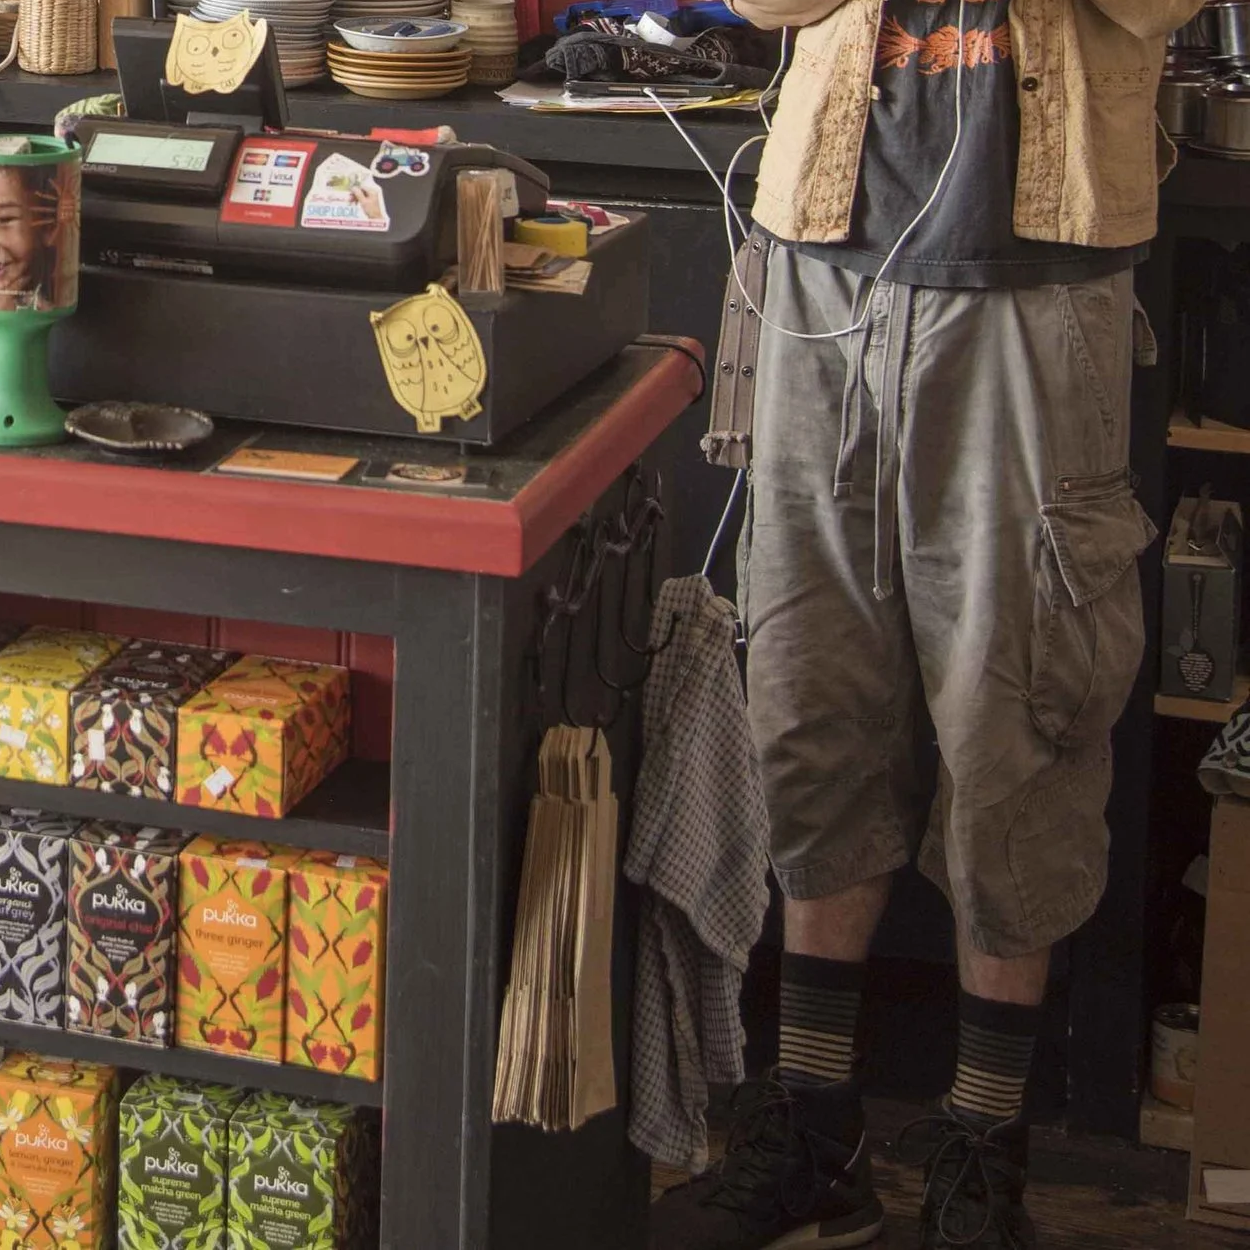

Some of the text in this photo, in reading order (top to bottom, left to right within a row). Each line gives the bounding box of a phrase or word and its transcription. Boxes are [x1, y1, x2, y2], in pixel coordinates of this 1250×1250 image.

[92, 889, 146, 914] pukka
[203, 904, 257, 929] pukka
[195, 928, 265, 949] three ginger
[15, 1129, 68, 1151] pukka
[145, 1152, 199, 1178] pukka
[141, 1184, 201, 1201] matcha green
[152, 1176, 191, 1190] supreme
[254, 1171, 309, 1197] pukka
[250, 1202, 311, 1221] matcha green
[261, 1194, 300, 1208] supreme
